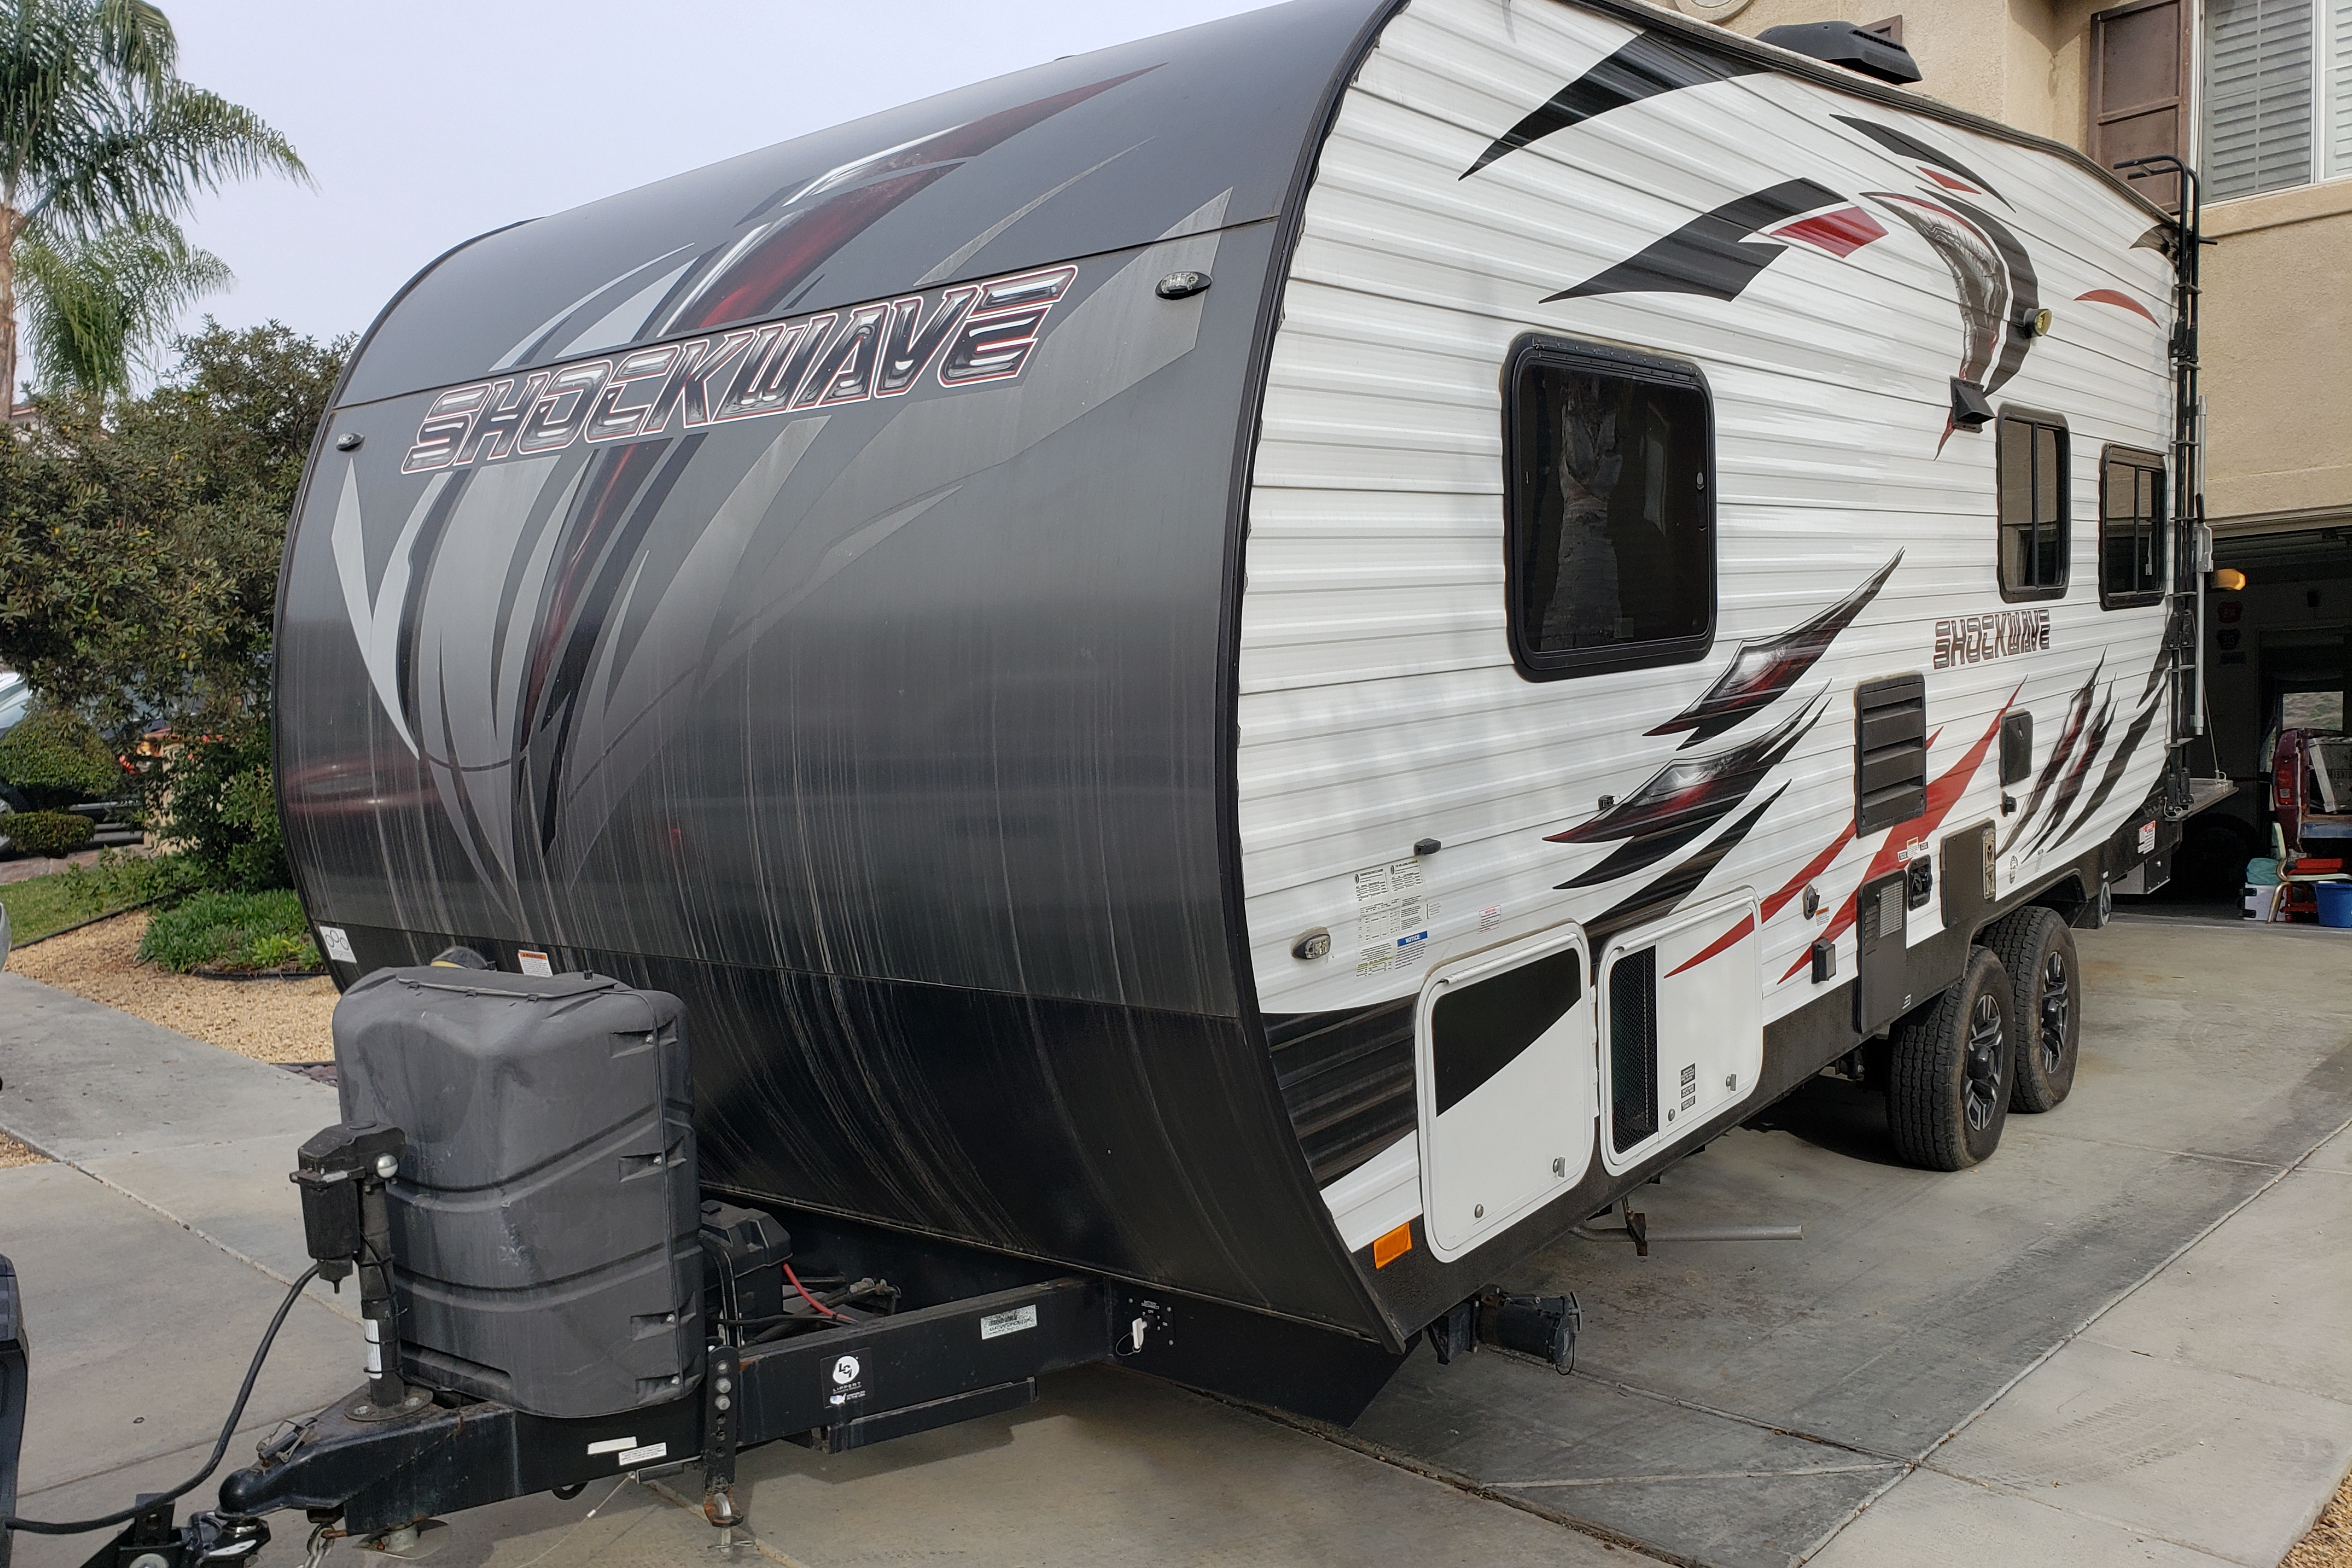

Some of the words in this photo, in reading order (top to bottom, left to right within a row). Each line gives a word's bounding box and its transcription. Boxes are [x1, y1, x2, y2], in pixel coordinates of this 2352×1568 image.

[400, 264, 1079, 475] SHOCKWAVE
[1933, 609, 2050, 670] SHOCKWAVE
[1405, 934, 1420, 943] NOTICE
[832, 1381, 861, 1392] LIPPERT
